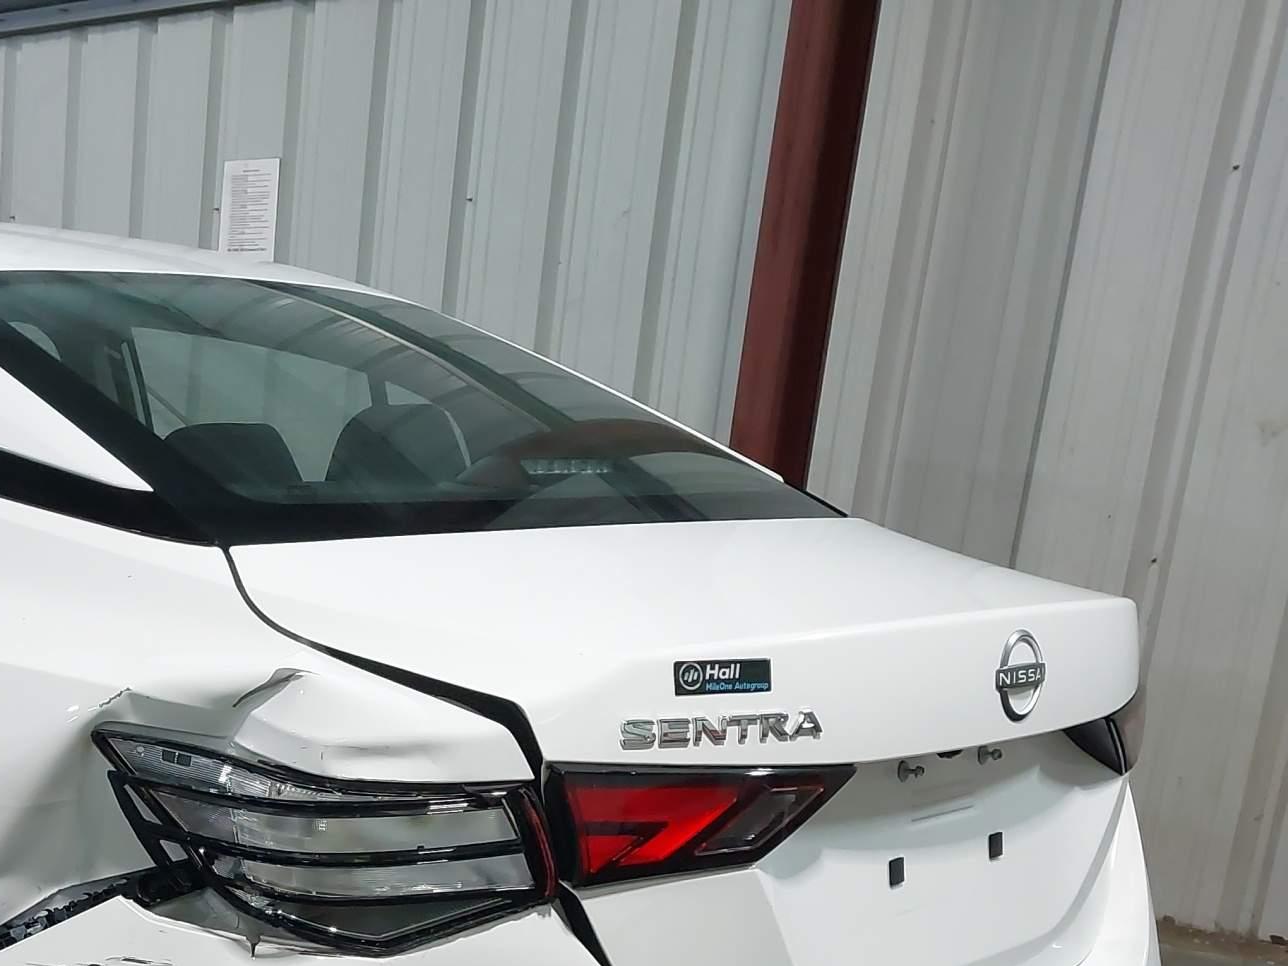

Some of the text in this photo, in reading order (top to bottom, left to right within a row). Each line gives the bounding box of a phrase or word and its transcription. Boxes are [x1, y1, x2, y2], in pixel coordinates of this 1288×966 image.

[705, 663, 741, 680] Hall
[999, 666, 1045, 687] NISSA
[705, 681, 769, 692] MileOne Autogroup
[619, 709, 823, 751] SENTRA
